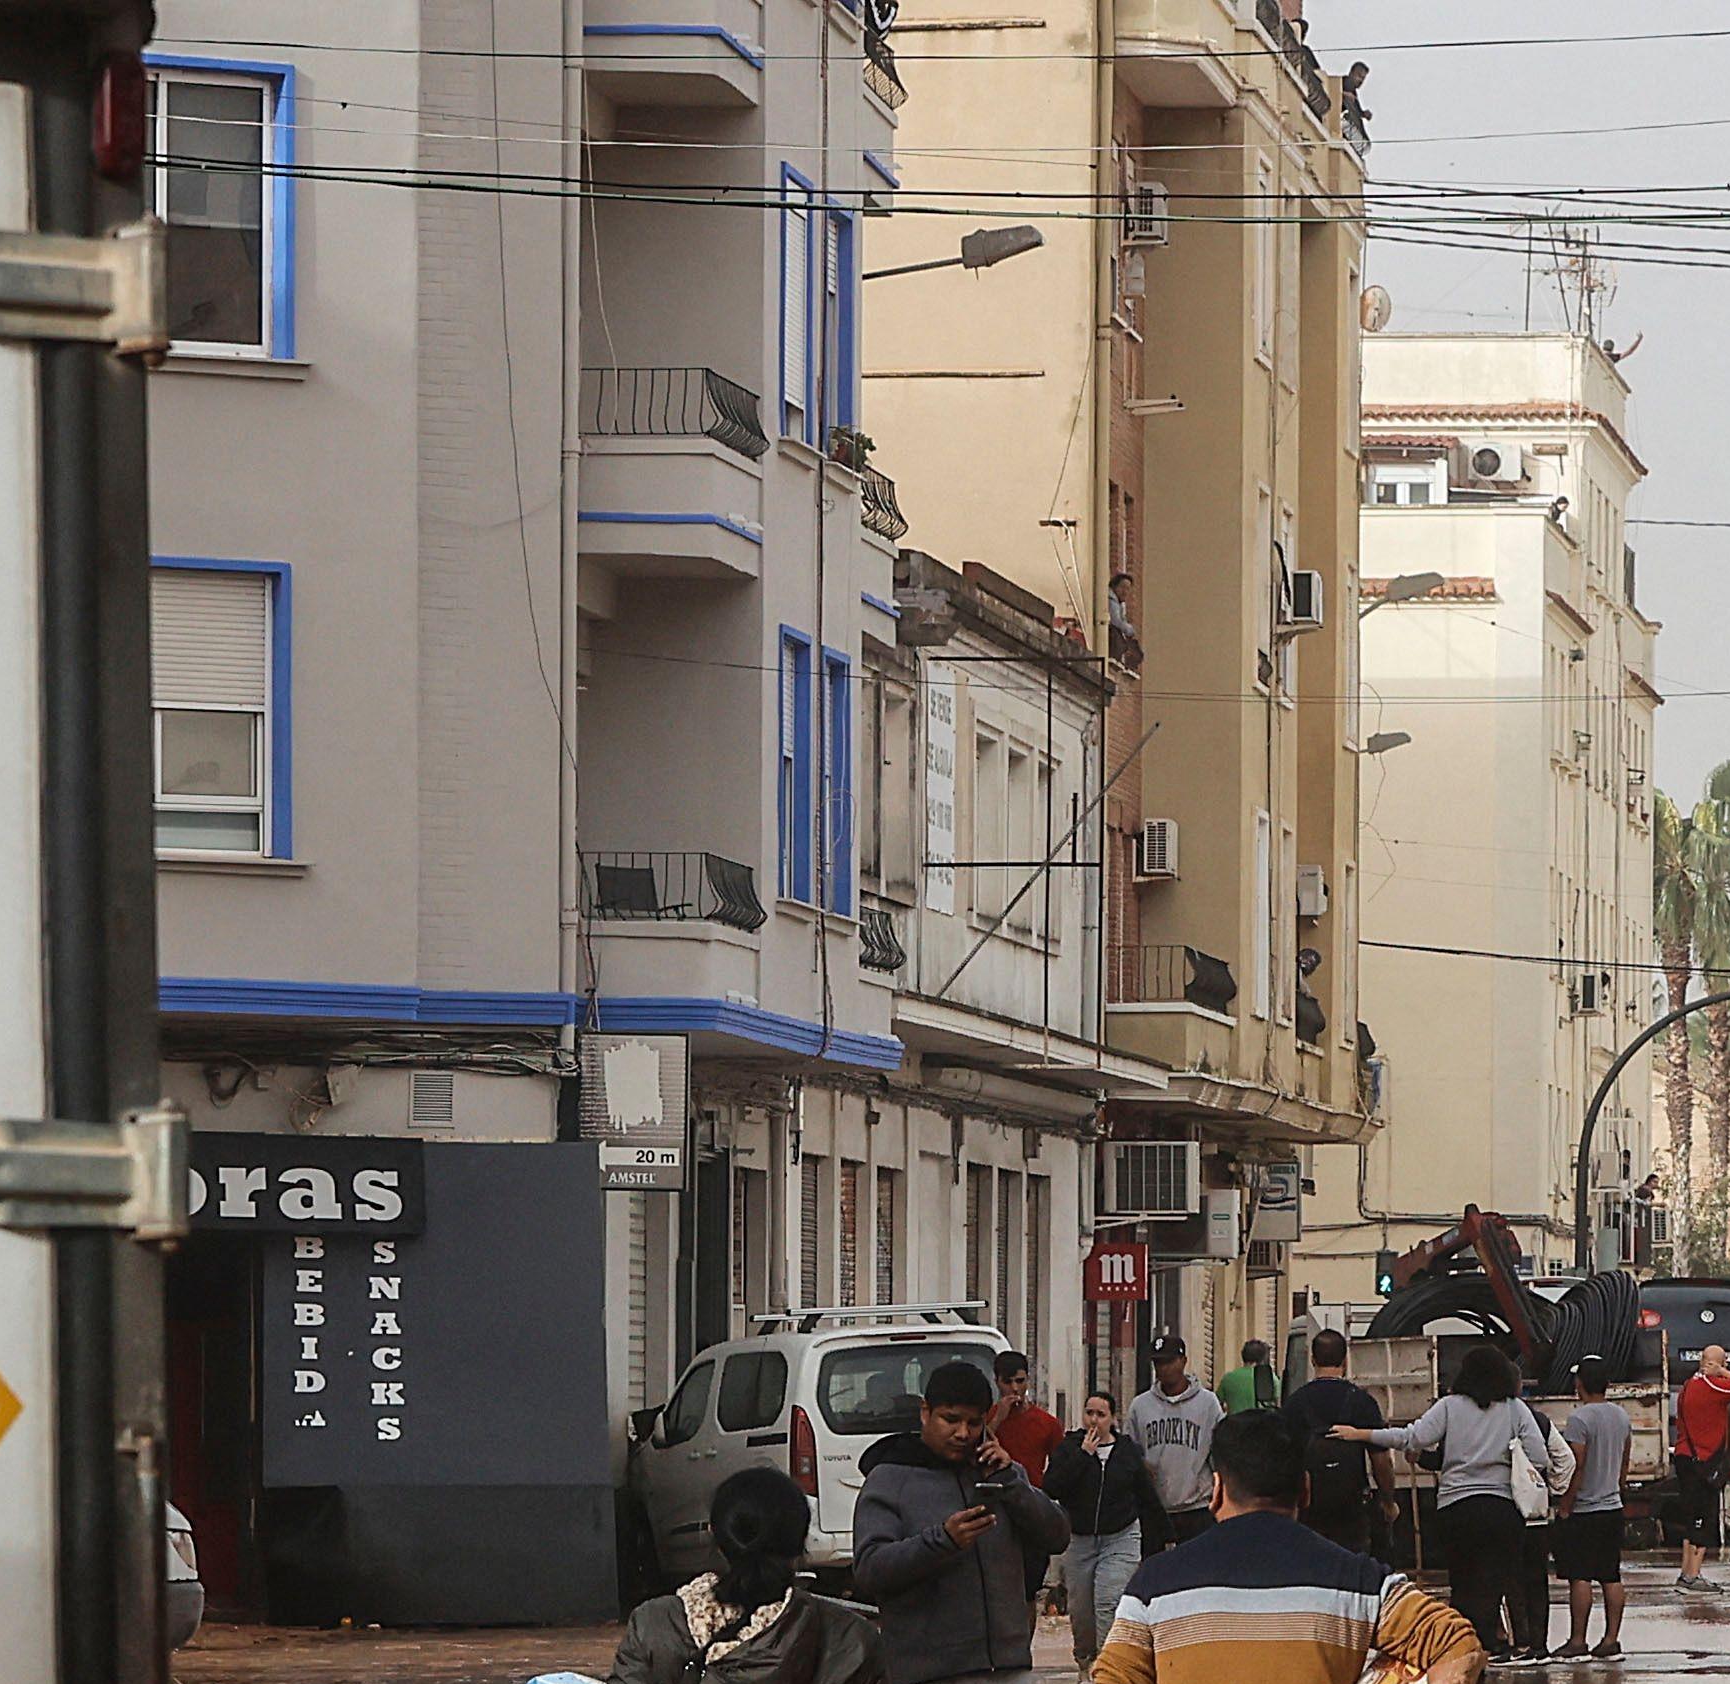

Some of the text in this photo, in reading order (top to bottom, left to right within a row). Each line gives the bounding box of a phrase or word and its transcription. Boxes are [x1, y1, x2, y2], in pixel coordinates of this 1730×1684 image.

[635, 1149, 675, 1164] 20 m
[608, 1171, 656, 1185] AMSTEL
[369, 1241, 405, 1440] SNACKS
[1145, 1417, 1201, 1452] BROOKLYN
[822, 1454, 852, 1463] TOYOTA
